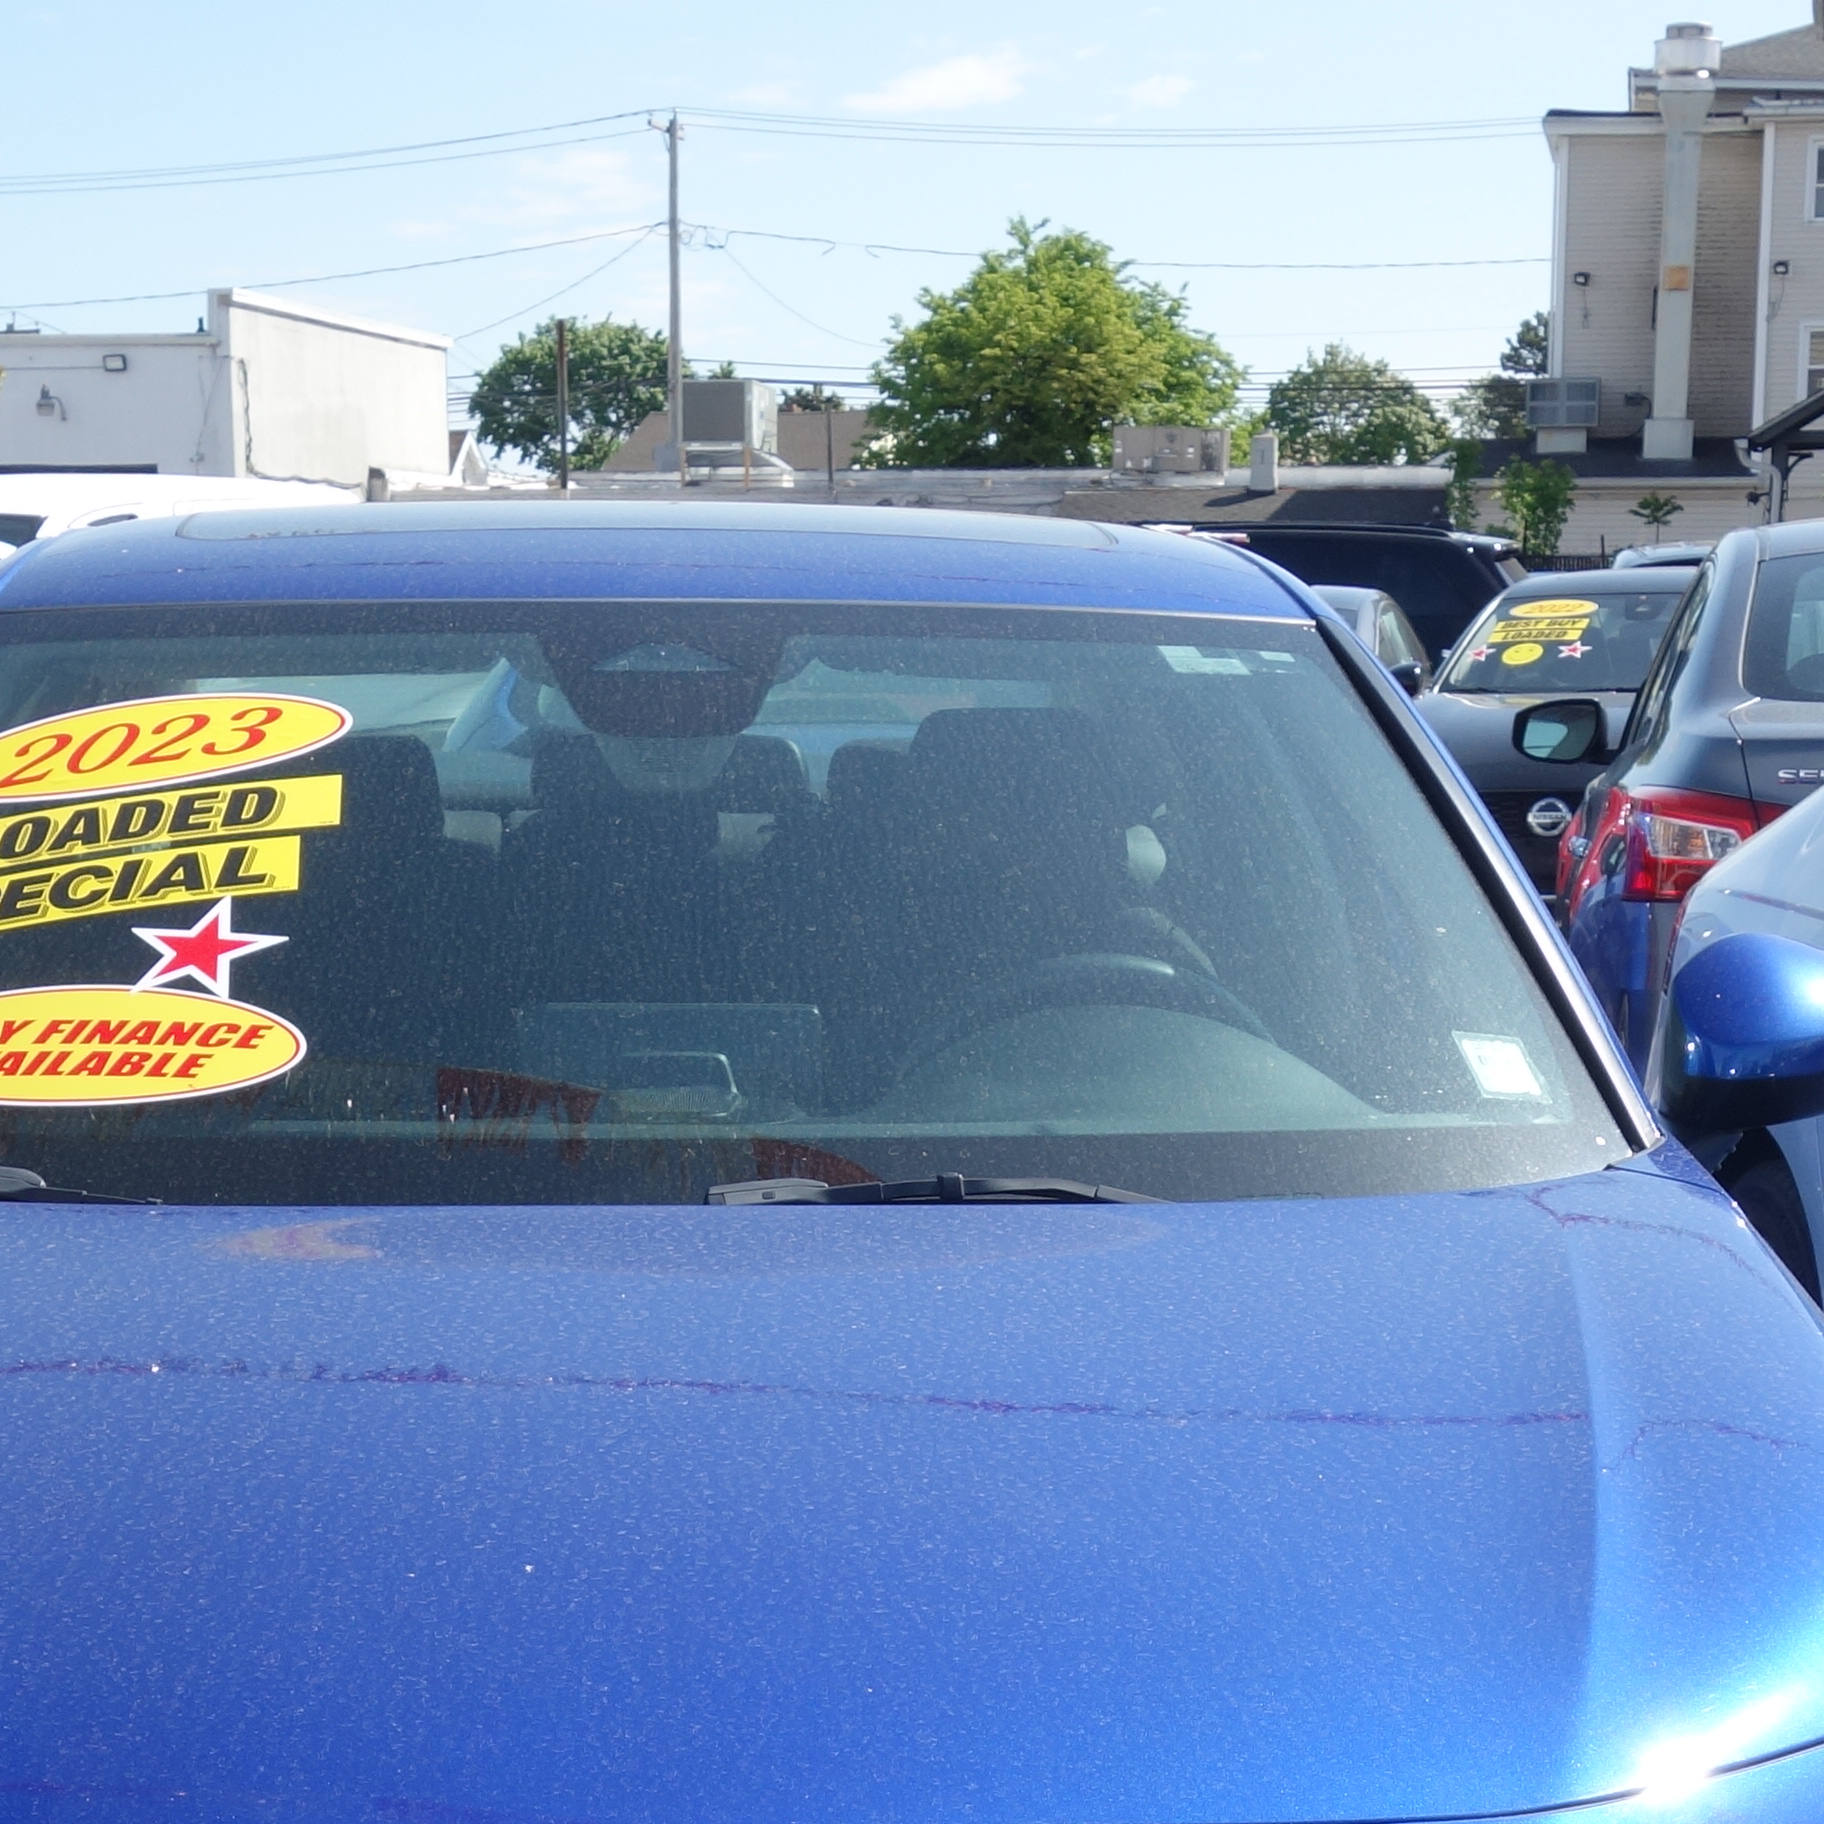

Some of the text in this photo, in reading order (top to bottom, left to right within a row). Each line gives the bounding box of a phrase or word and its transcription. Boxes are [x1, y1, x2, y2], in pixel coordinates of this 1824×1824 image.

[1502, 619, 1581, 629] BEST BUY
[1502, 631, 1568, 640] LOADED
[40, 1019, 274, 1049] FINANCE
